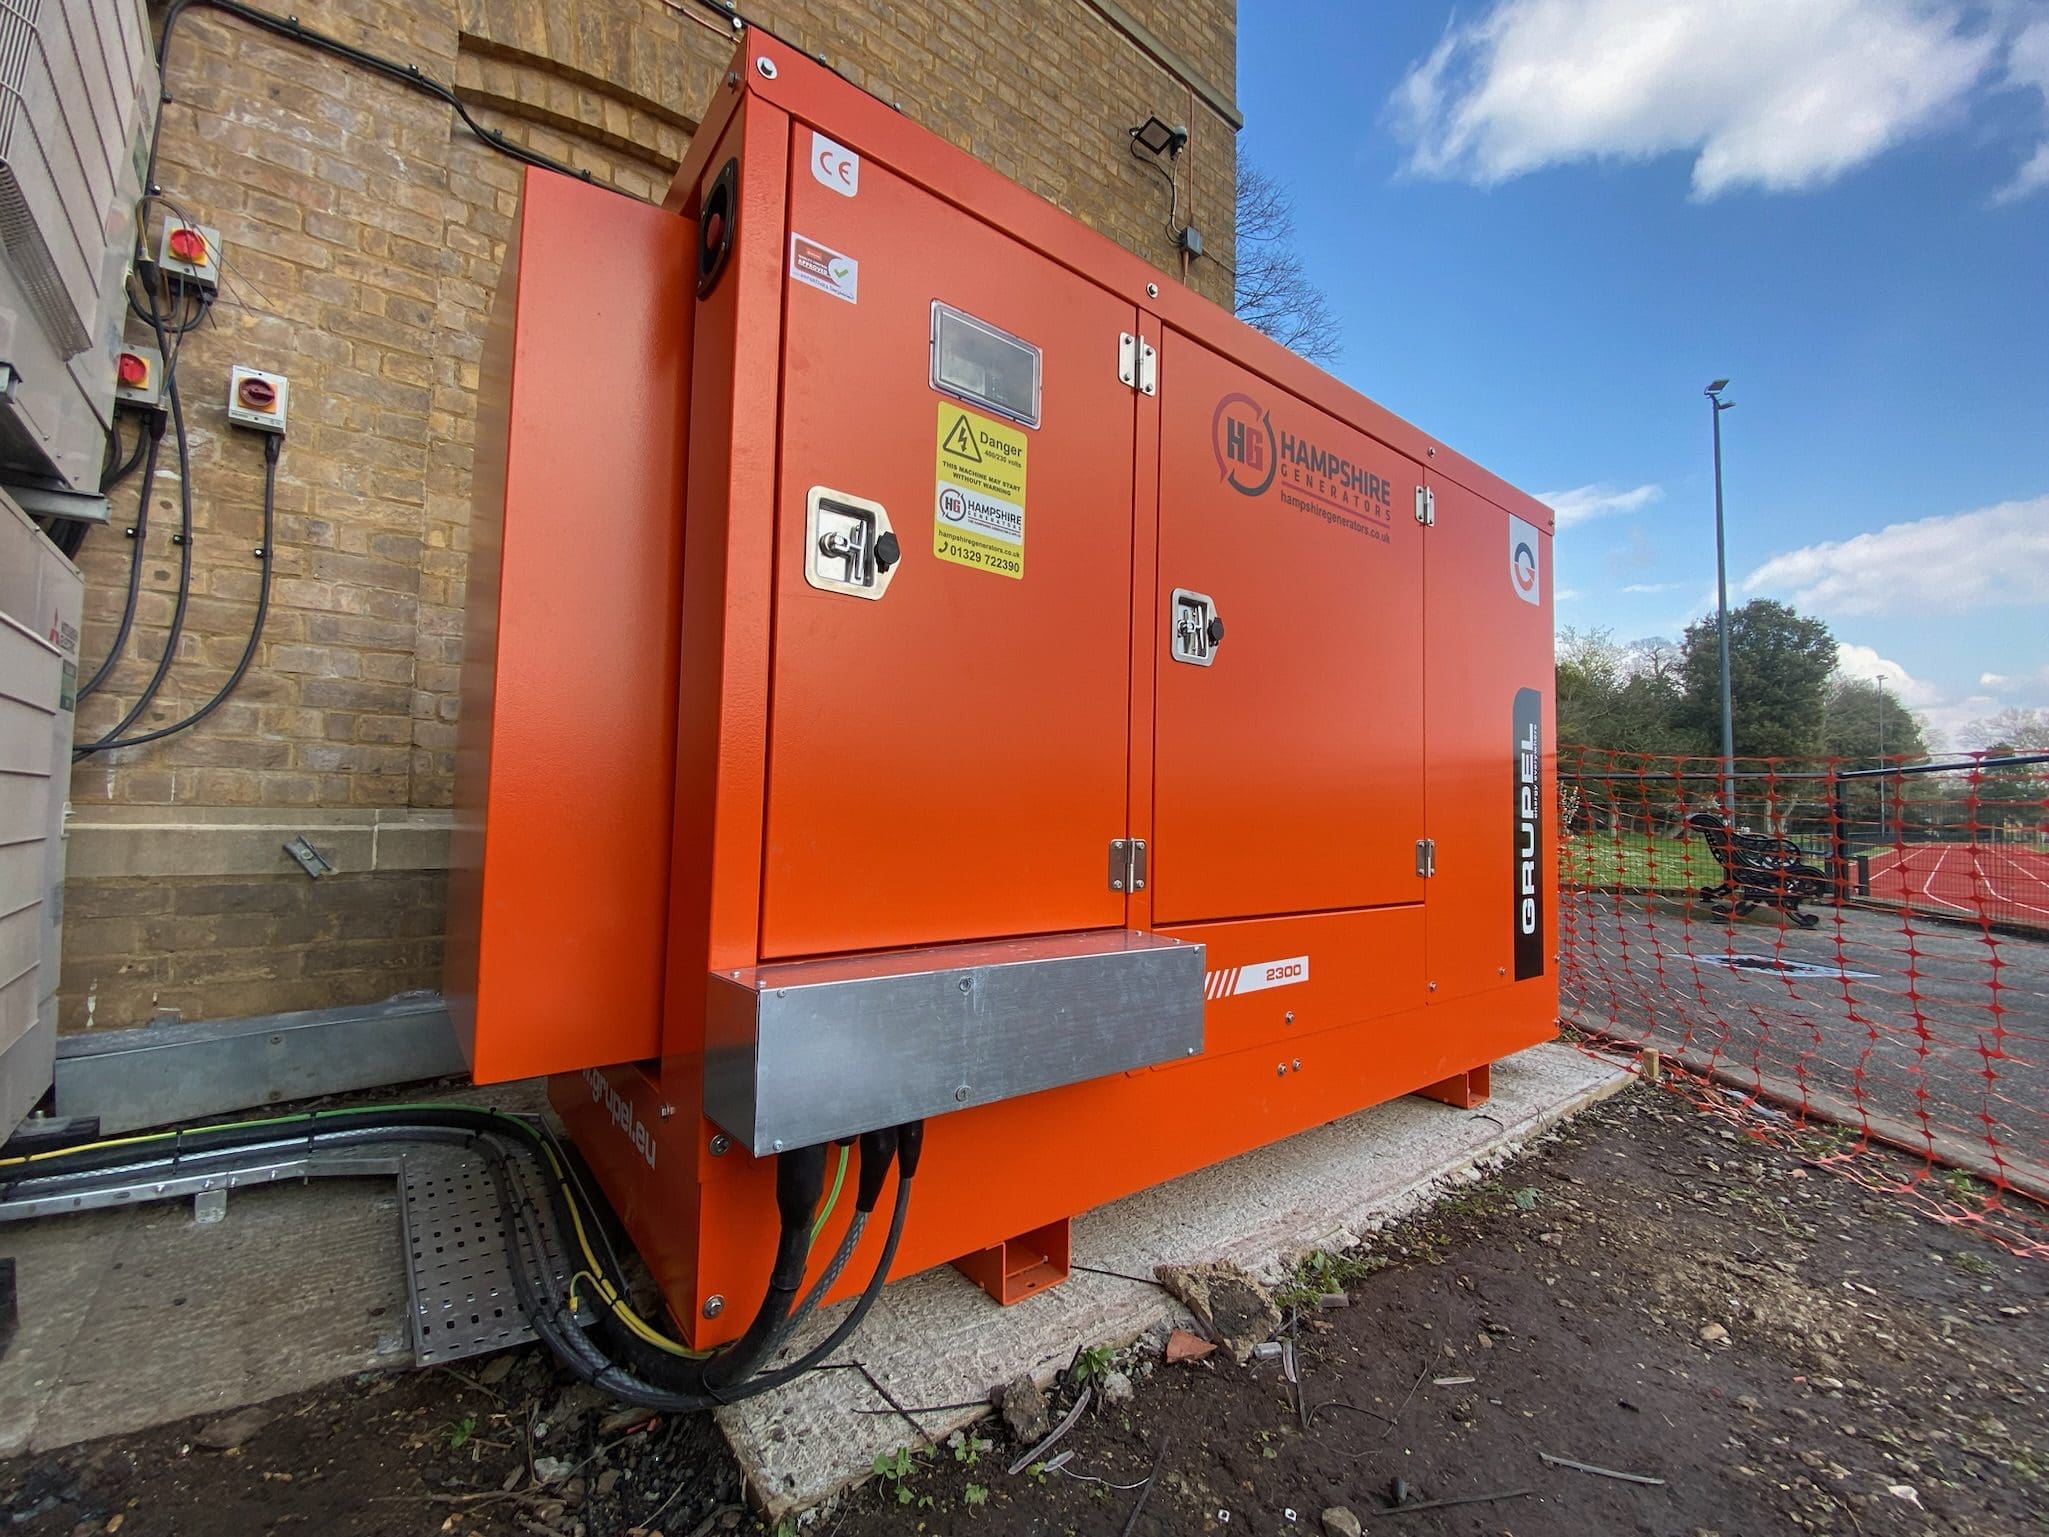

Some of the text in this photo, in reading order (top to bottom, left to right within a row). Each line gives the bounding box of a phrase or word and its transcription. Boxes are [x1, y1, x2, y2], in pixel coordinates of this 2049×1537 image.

[819, 151, 852, 186] CE
[980, 431, 1022, 457] Danger
[1227, 416, 1264, 473] HG
[942, 460, 1021, 492] THIS MACHINE MAY START
[953, 471, 1012, 496] WITHOUT WARNING
[1280, 430, 1391, 507] HAMPSHIRE
[945, 496, 961, 514] HG
[1280, 463, 1391, 521] GENERATORS
[968, 500, 1022, 525] HAMPSHIRE
[1280, 490, 1391, 544] hampshiregenerators.co.uk
[938, 529, 1021, 558] hampshiregenerators.co.uk
[950, 545, 1020, 573] 01329 722390
[1521, 723, 1535, 935] GRUPEL
[1266, 964, 1302, 981] 2300
